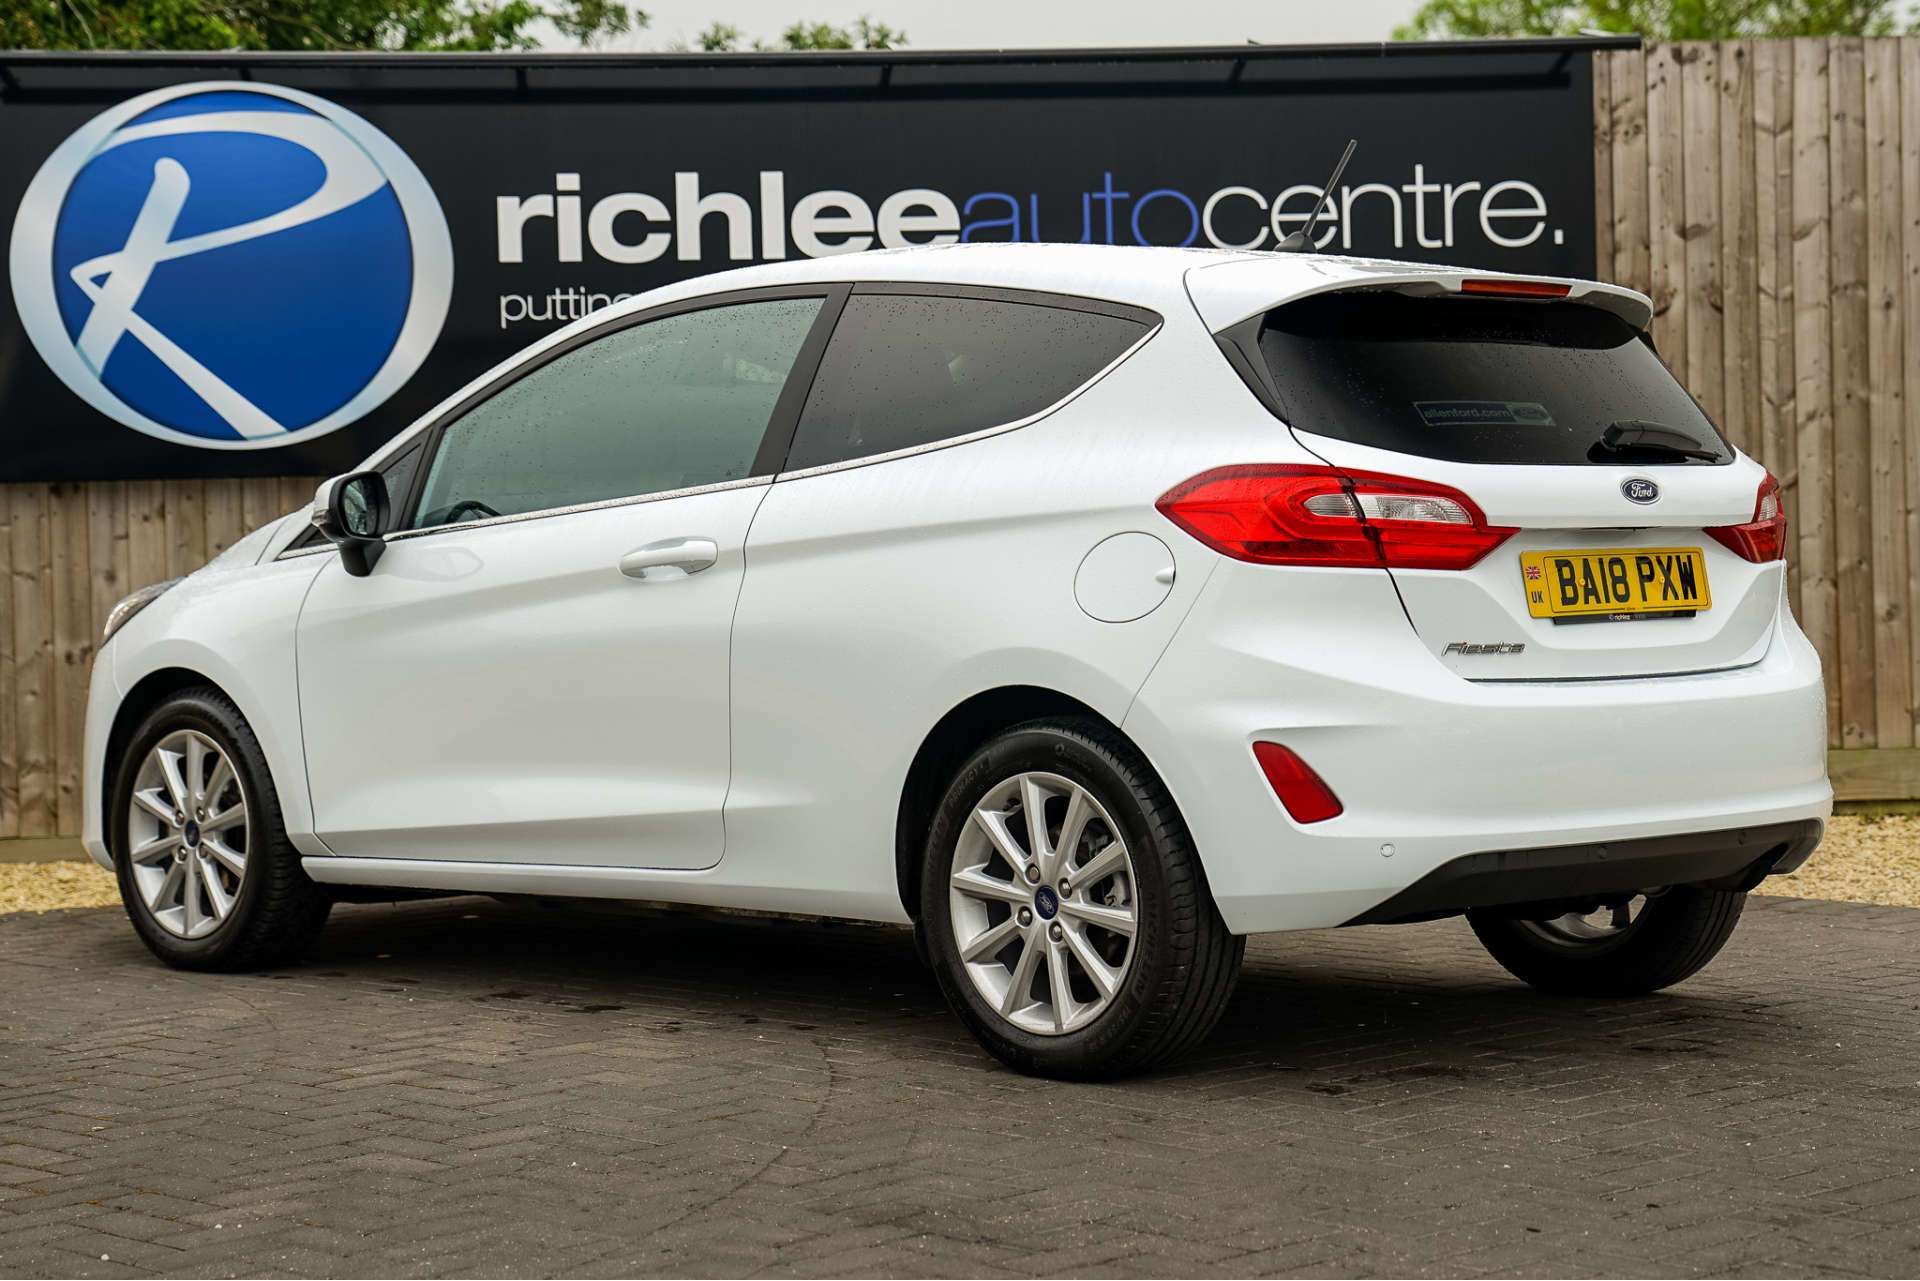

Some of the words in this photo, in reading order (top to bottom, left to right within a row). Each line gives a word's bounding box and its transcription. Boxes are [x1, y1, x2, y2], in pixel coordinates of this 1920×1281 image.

[70, 111, 389, 440] R
[500, 286, 632, 329] puttin
[1631, 482, 1654, 498] Ford
[1554, 557, 1630, 606] BA18
[1635, 555, 1697, 602] PXW
[1531, 591, 1544, 604] UK
[1441, 641, 1525, 656] Fiesta
